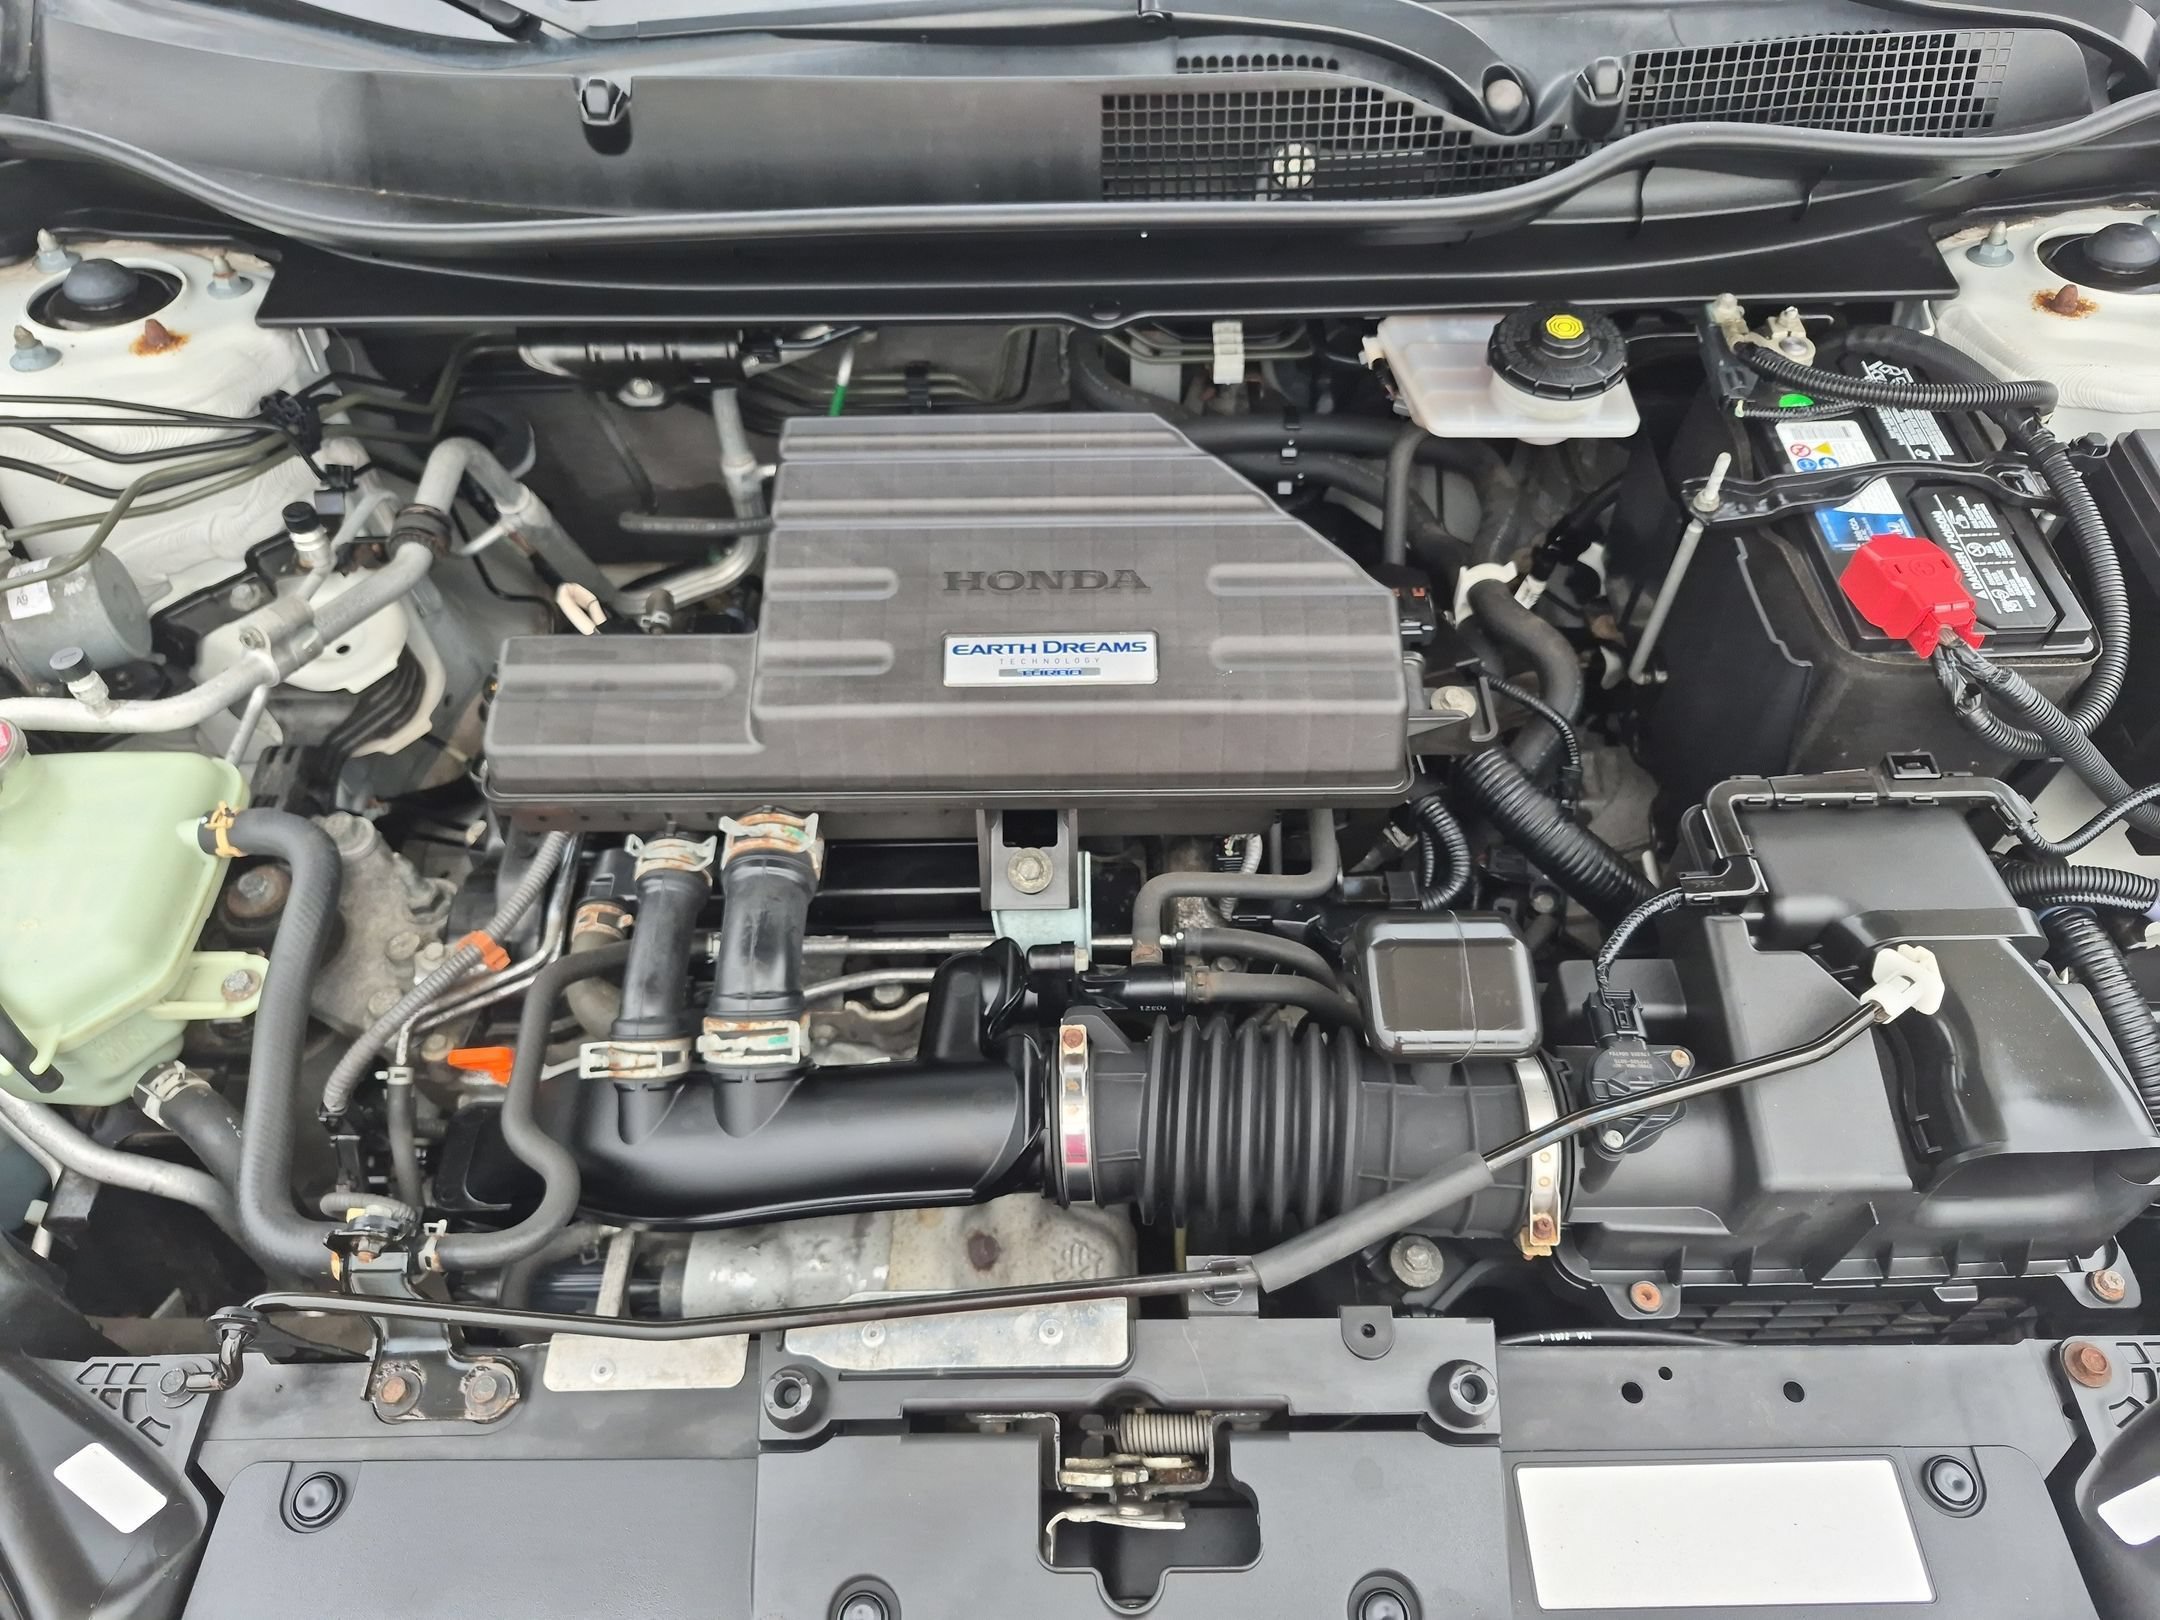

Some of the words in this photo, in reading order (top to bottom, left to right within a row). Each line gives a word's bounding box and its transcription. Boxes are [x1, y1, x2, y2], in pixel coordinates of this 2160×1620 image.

[1931, 510, 1958, 544] POISON
[943, 569, 1151, 592] HONDA
[1954, 551, 1984, 589] DANGER
[952, 642, 1036, 655] EARTH
[1043, 640, 1147, 654] DREAMS
